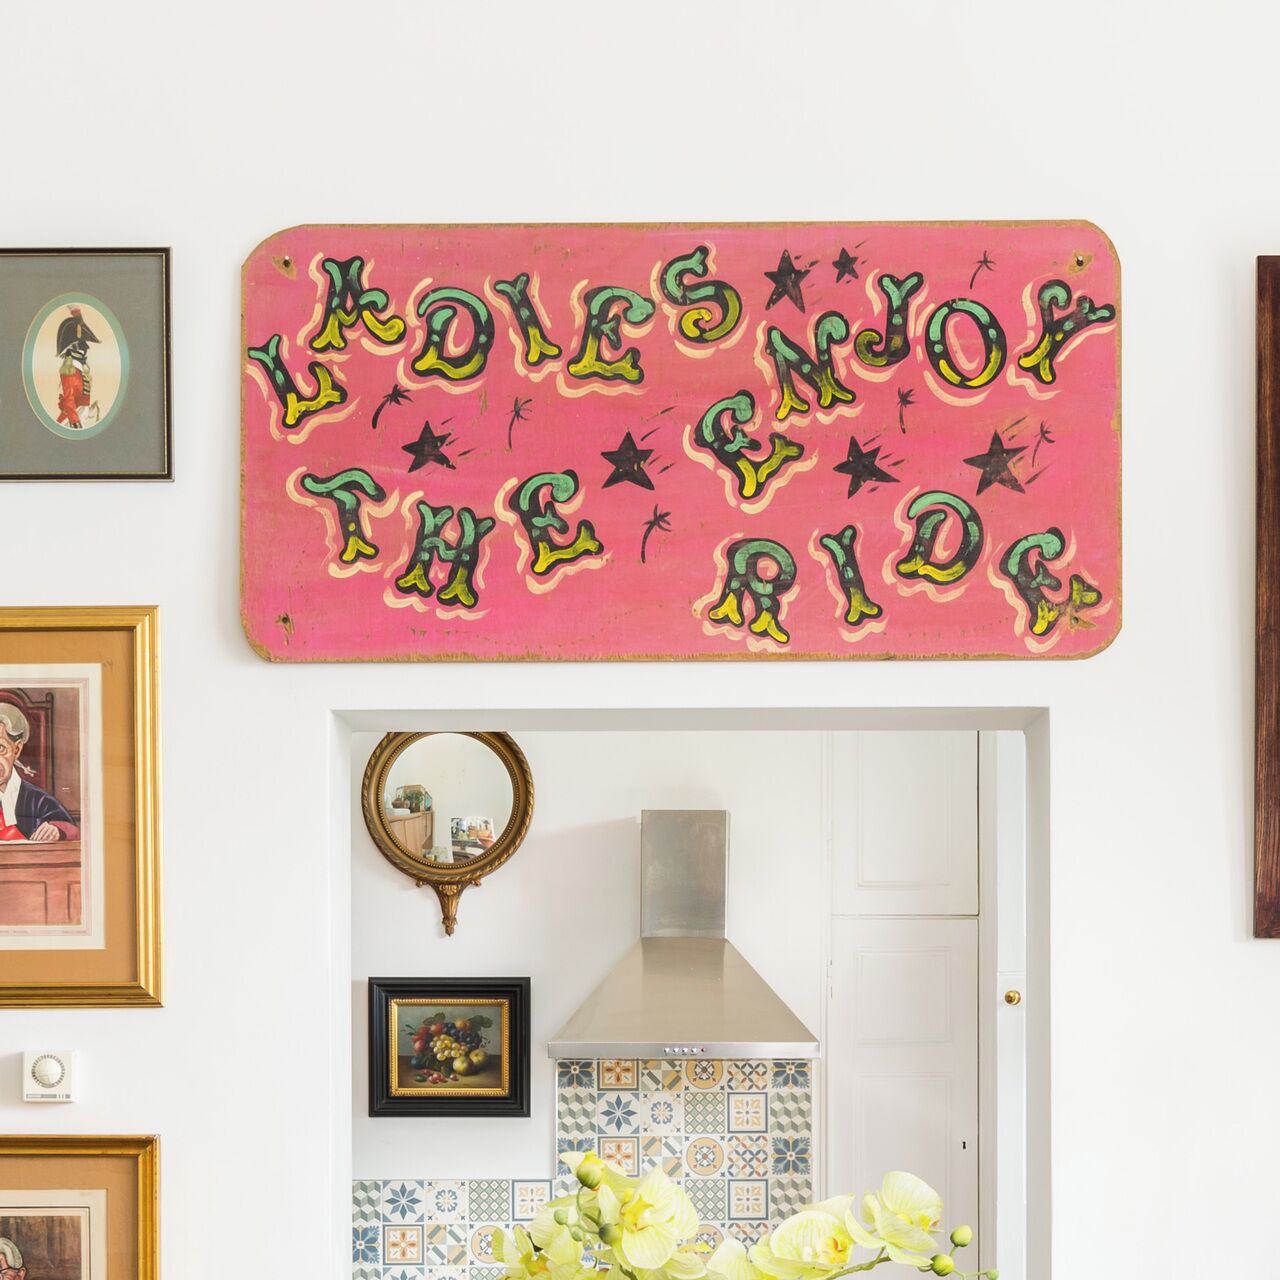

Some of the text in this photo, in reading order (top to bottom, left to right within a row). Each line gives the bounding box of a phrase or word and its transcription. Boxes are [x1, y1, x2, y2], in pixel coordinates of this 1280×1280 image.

[246, 243, 1117, 500] LADIES ENJOY
[299, 467, 1103, 643] THE RIDE
